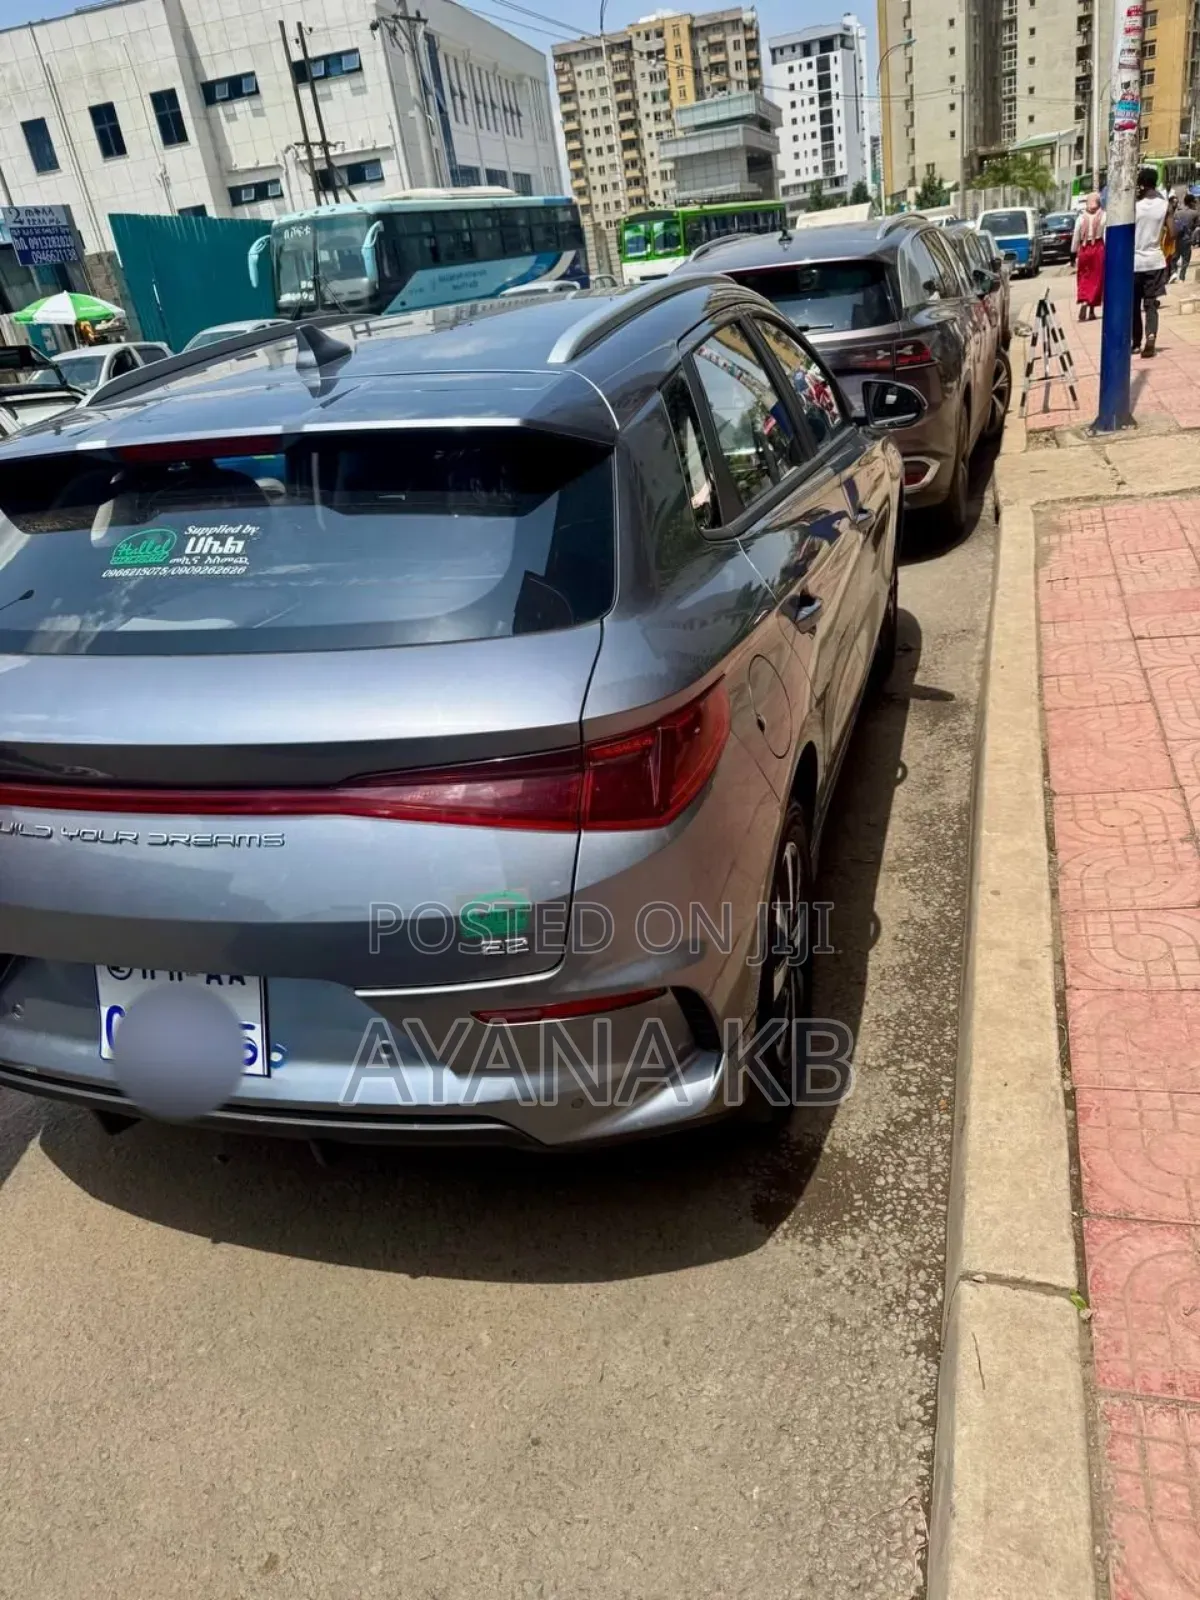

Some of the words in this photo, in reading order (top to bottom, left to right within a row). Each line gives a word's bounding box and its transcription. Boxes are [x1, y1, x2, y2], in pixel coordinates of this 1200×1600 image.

[184, 525, 241, 536] Supplied
[242, 524, 260, 536] by
[60, 827, 139, 845] YOUR
[148, 832, 285, 848] DREAMS
